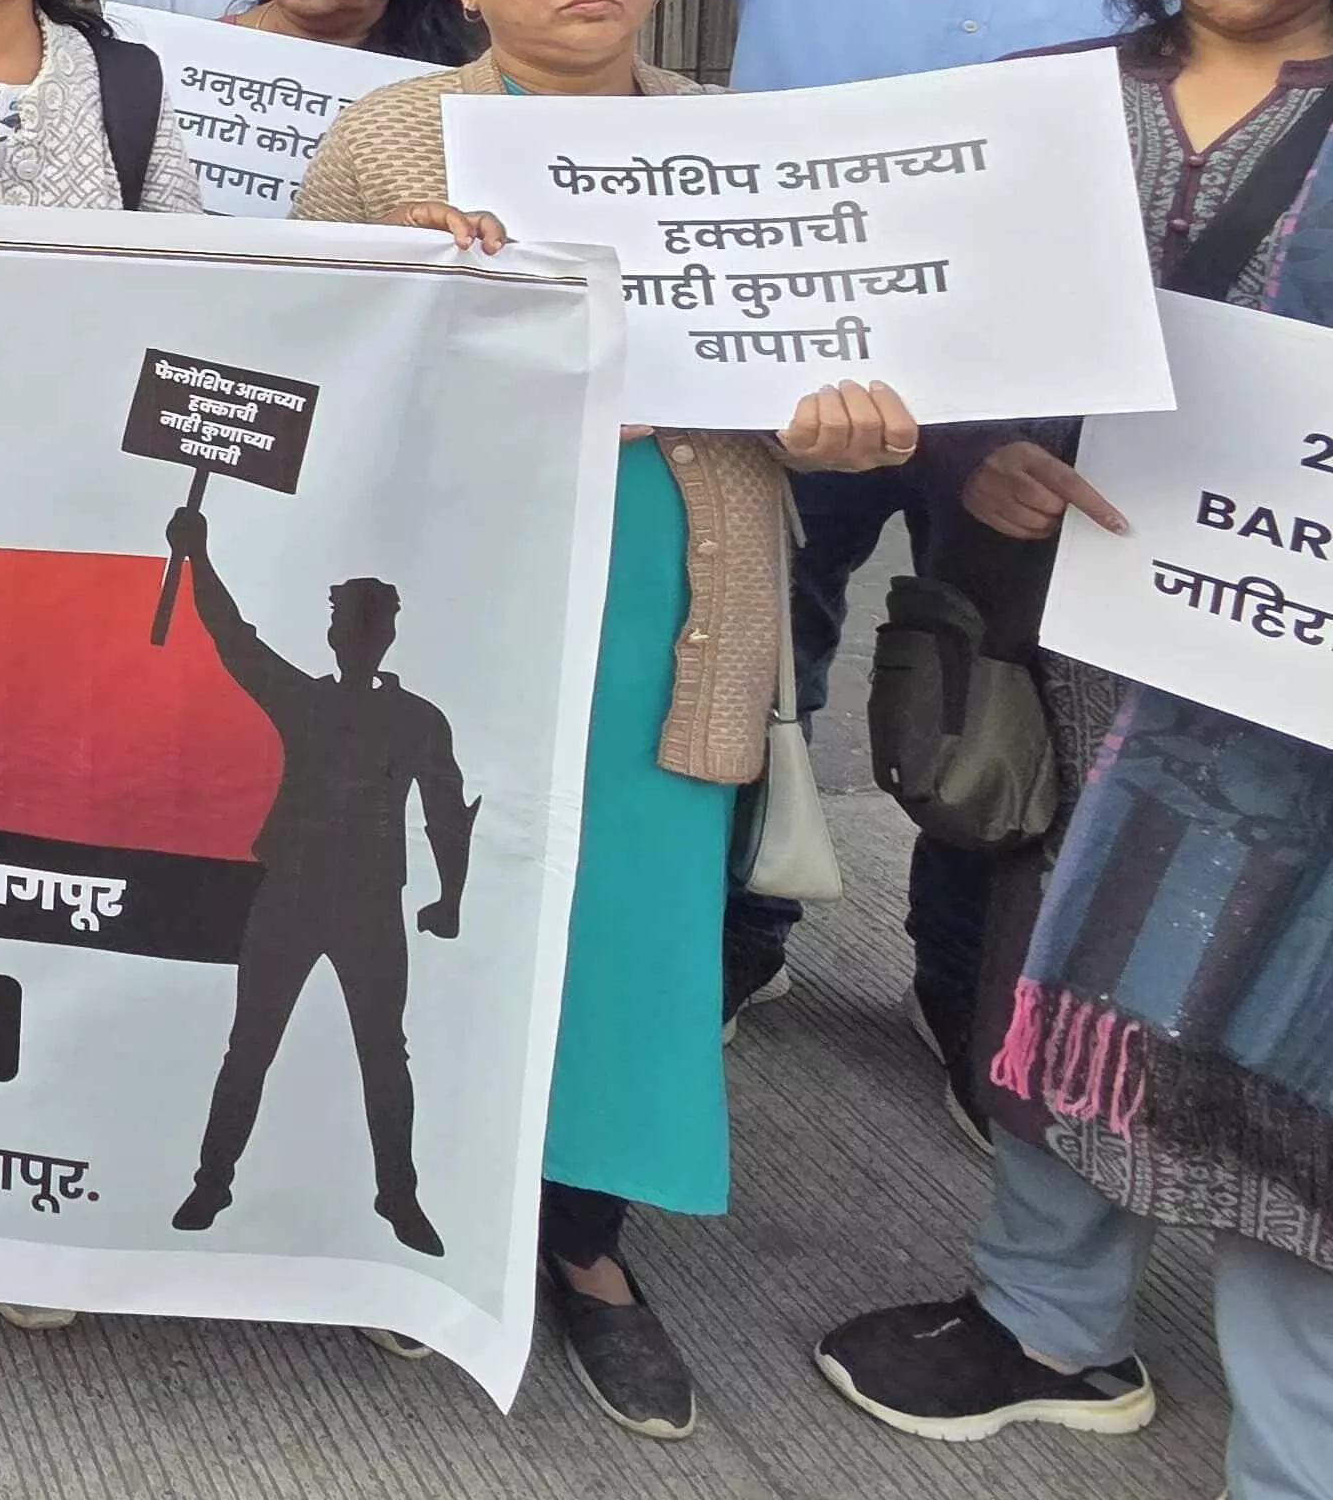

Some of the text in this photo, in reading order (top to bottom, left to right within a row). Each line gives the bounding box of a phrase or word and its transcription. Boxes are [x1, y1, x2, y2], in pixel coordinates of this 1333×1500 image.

[181, 66, 331, 117] अनुसूचित
[548, 138, 988, 197] फेलोशिप आमच्या
[658, 200, 868, 255] हक्काची
[725, 259, 948, 316] कुणाच्या
[689, 316, 870, 363] बापाची
[155, 360, 307, 412] फेलोशिप आमच्या
[189, 394, 258, 423] हक्काची
[160, 410, 276, 451] नाही कुणाच्या
[180, 438, 241, 465] बापाची
